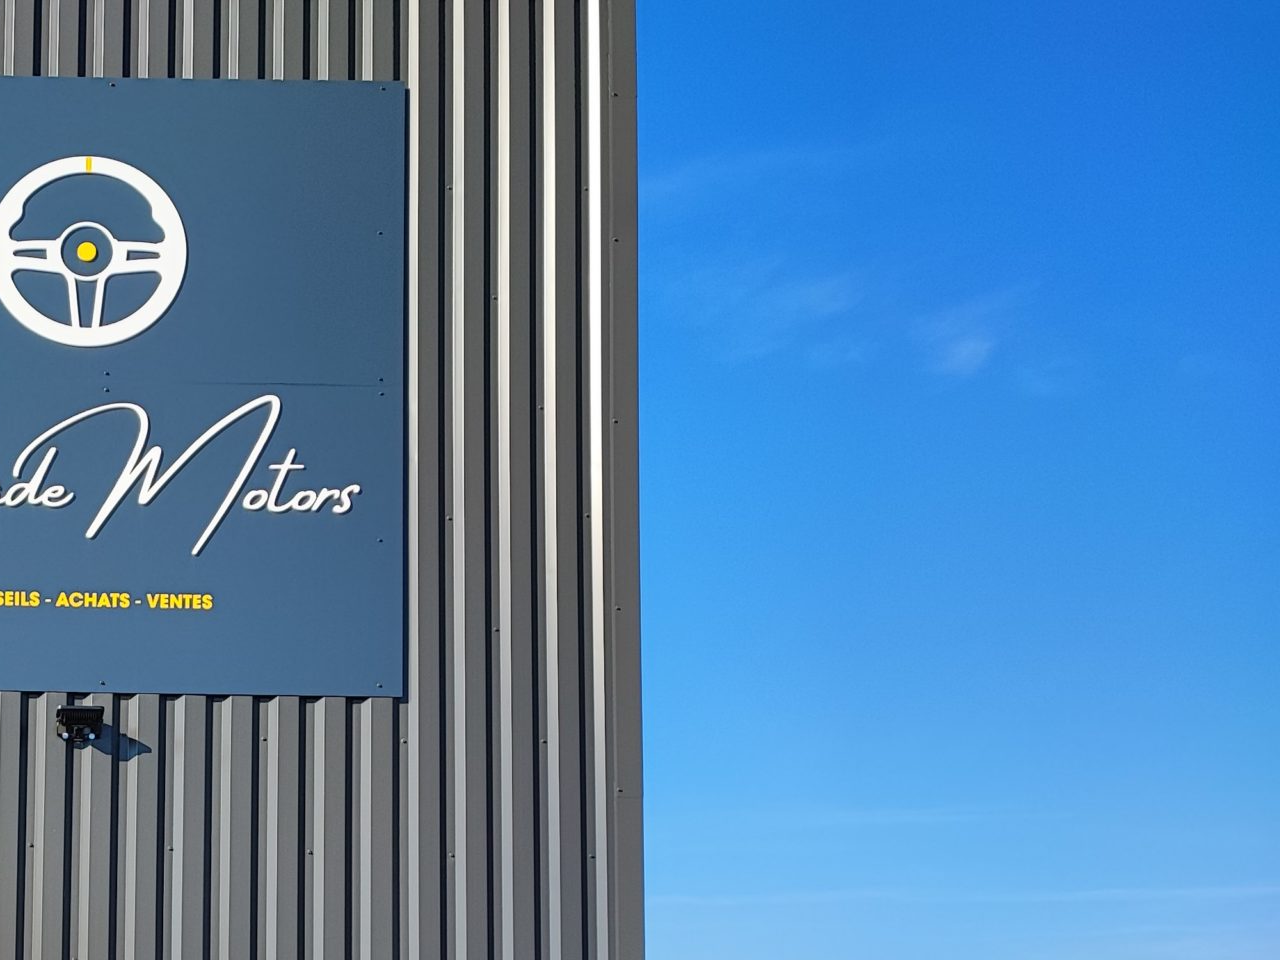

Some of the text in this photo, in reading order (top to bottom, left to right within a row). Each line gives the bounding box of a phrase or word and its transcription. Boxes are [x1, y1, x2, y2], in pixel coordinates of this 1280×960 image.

[13, 394, 361, 556] Motors
[55, 591, 130, 609] ACHATS
[146, 593, 213, 610] VENTES
